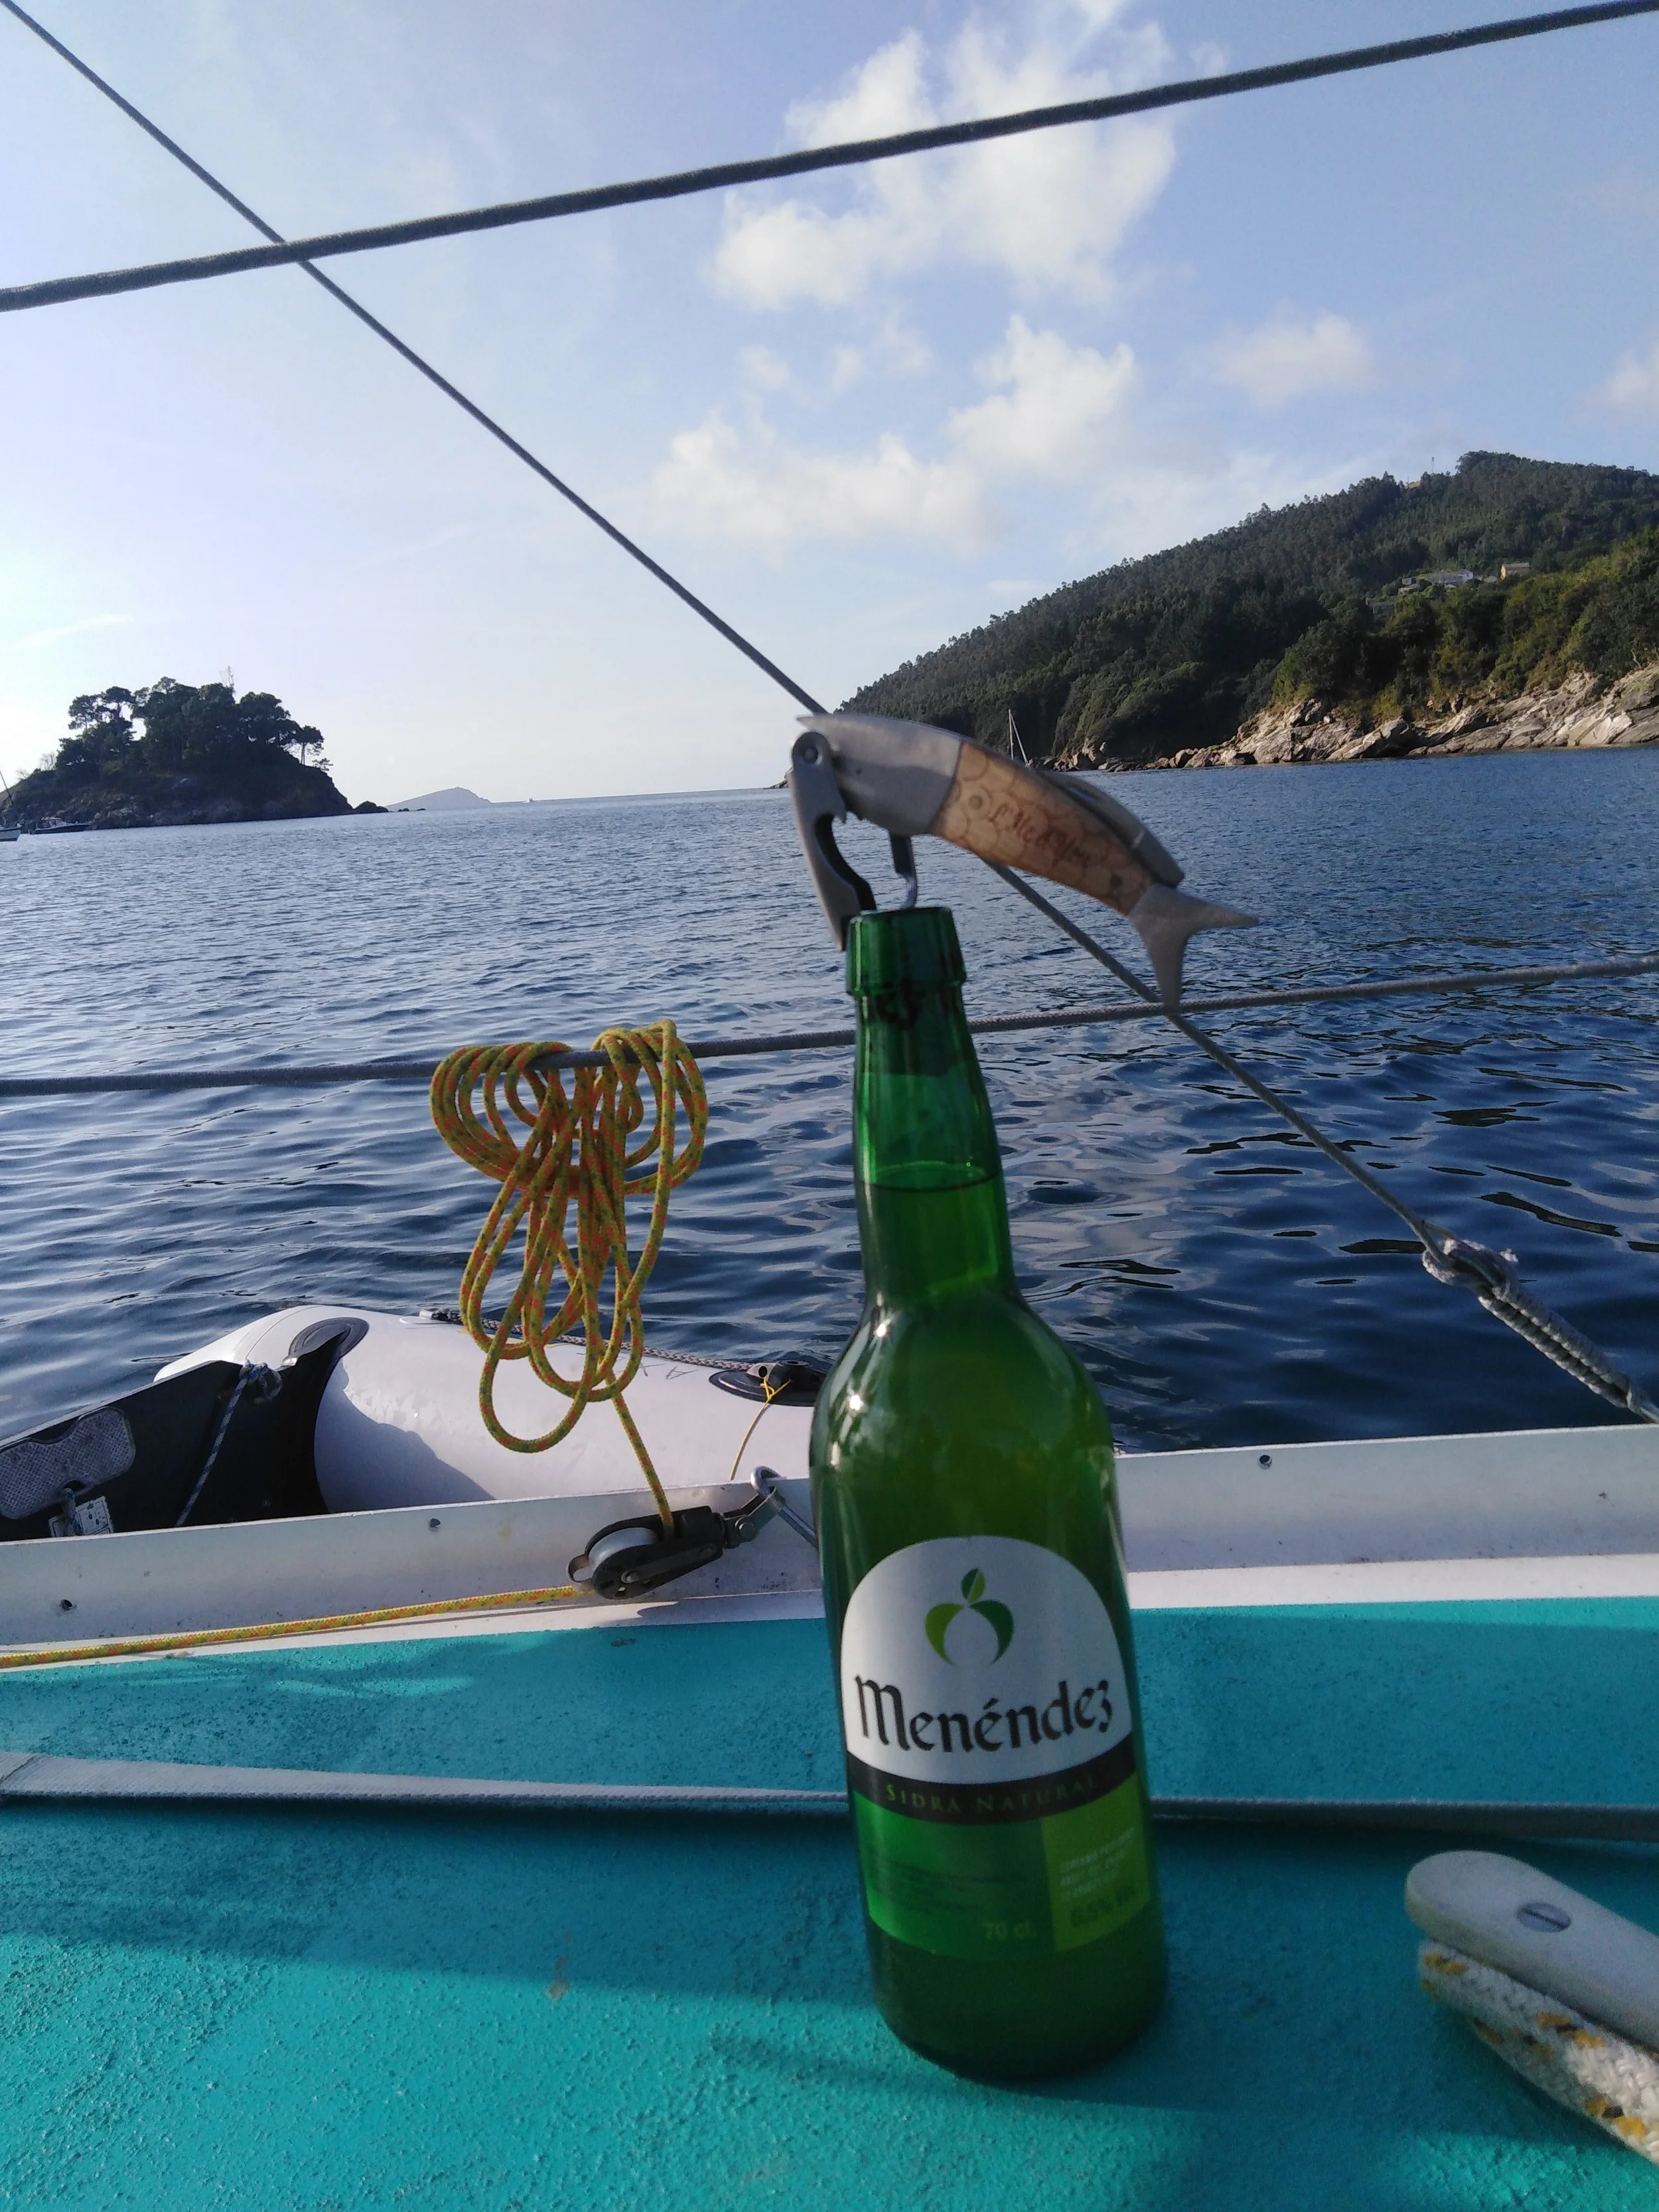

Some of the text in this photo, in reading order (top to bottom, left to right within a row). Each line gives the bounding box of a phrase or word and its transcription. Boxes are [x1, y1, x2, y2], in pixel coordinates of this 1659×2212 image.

[855, 1674, 1113, 1753] Menéndez
[886, 1776, 1095, 1814] SIDRA NATURAL
[982, 1920, 1009, 1943] 70
